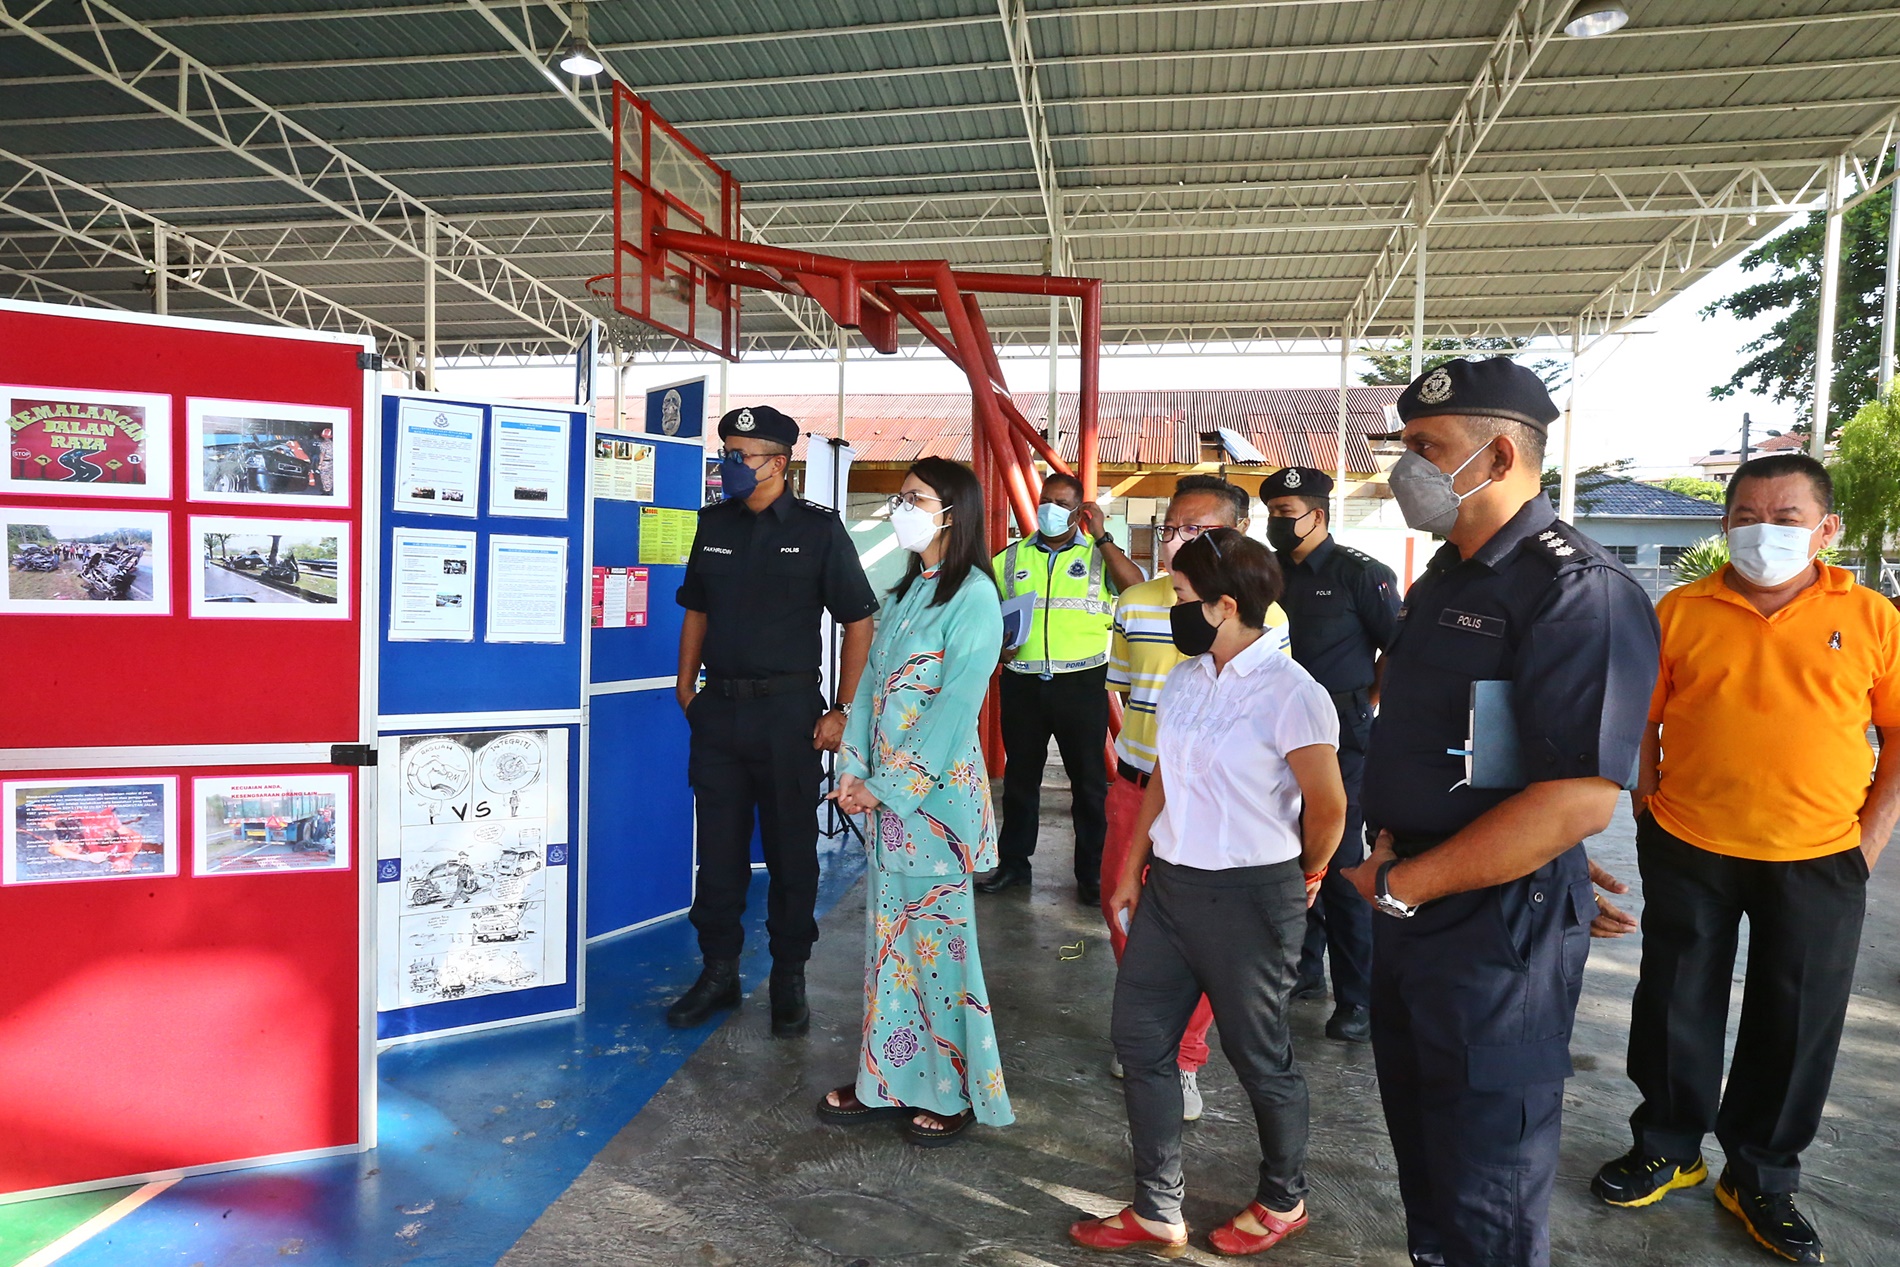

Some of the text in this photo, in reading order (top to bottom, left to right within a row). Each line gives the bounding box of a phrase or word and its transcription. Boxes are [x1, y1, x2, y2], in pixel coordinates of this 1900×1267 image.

[5, 404, 148, 442] KEMALANGAN
[42, 420, 116, 437] JALAN
[51, 435, 107, 451] RAYA
[14, 450, 30, 458] STOP
[1456, 615, 1483, 629] POLIS
[1065, 660, 1087, 669] PDRM
[490, 738, 532, 752] INTEGRITI
